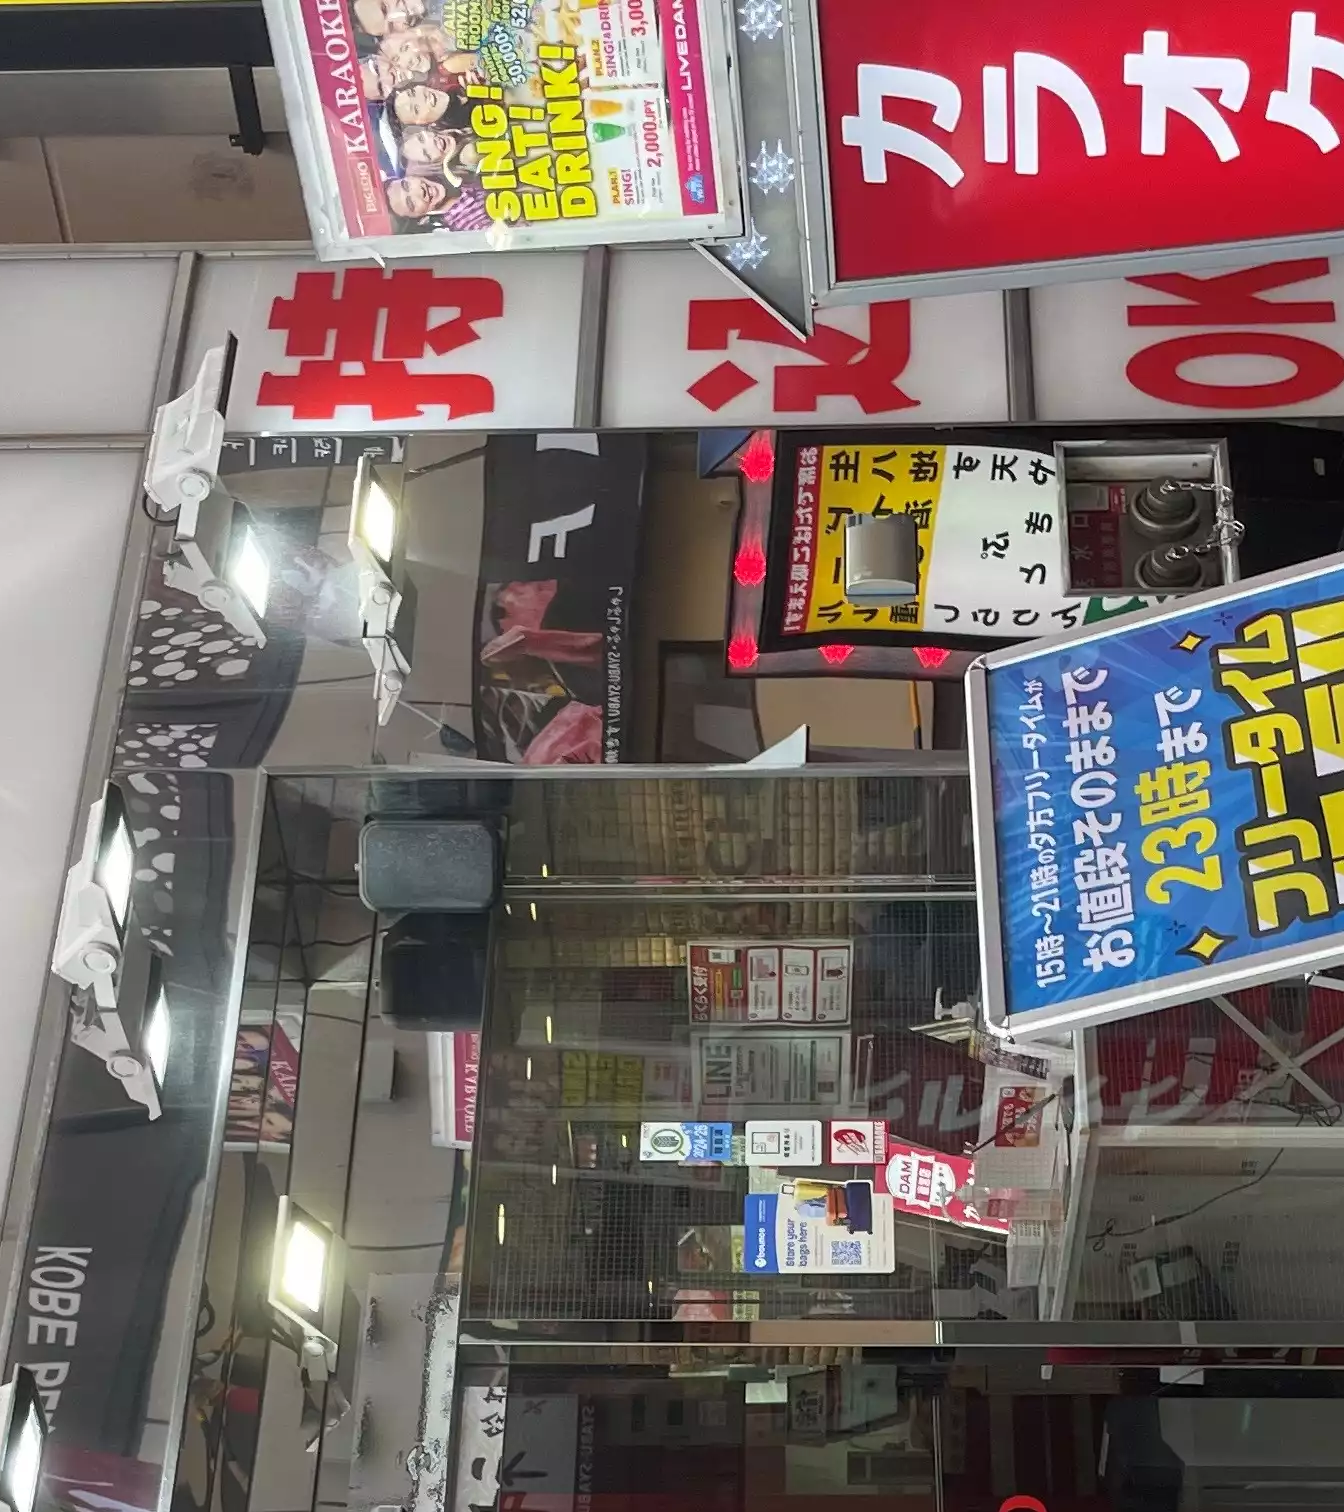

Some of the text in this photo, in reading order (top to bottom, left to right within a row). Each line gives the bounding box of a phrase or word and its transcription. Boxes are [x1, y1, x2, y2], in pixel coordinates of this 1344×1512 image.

[455, 0, 468, 50] PRIVA
[468, 0, 482, 46] ROOM
[466, 84, 521, 221] SING!
[508, 105, 560, 222] EAT!
[539, 43, 597, 218] DRINK!
[621, 168, 635, 205] SING!
[1059, 666, 1137, 973] お値段そのままで
[1133, 684, 1224, 905] 23時まで
[1216, 613, 1331, 931] フリータイム
[706, 1044, 732, 1099] LINE
[898, 1159, 912, 1195] DAM
